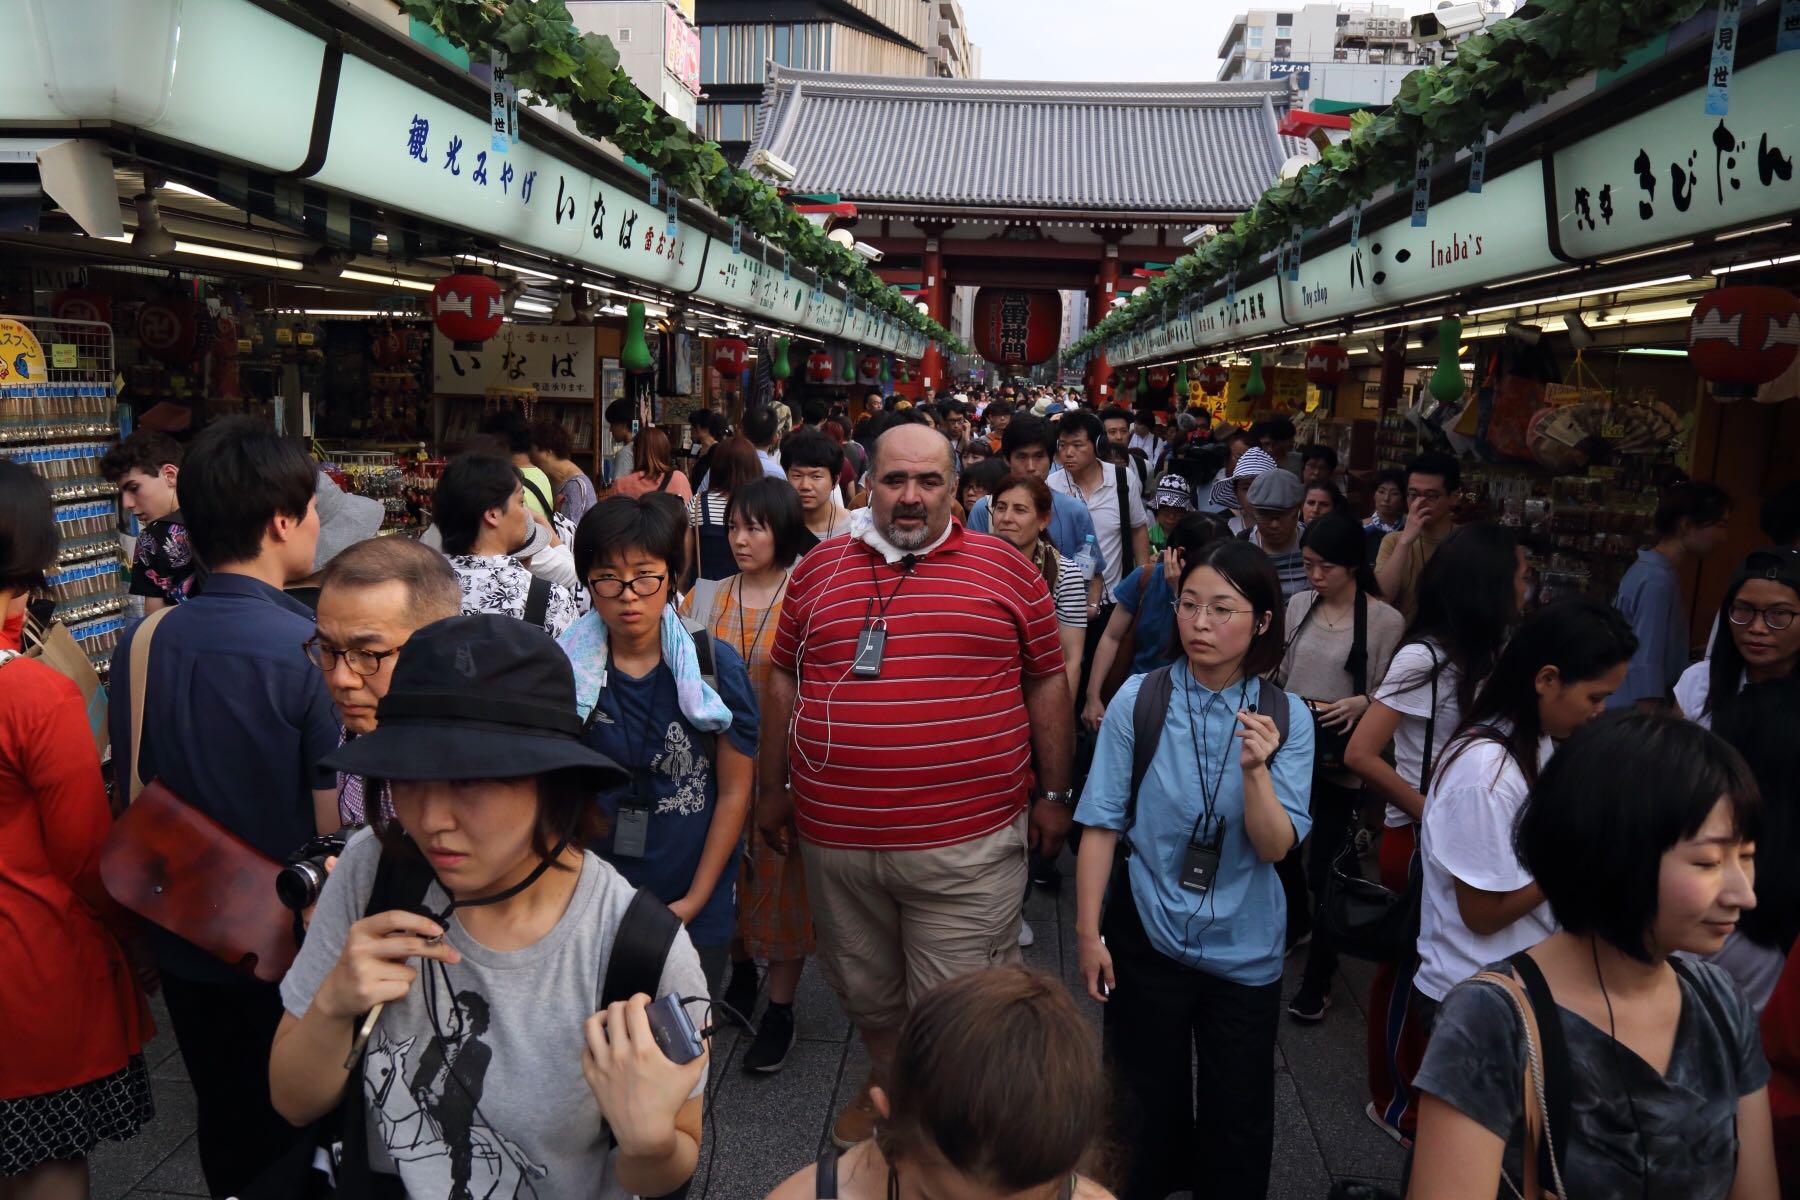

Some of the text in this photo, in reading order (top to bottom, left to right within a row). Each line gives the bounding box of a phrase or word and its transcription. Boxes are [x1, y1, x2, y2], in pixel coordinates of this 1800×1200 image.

[407, 113, 537, 204] 観光みやげ
[556, 176, 638, 249] いなば
[1634, 118, 1793, 220] きびだん
[1431, 233, 1482, 268] Inaba's
[1302, 280, 1328, 308] Toy shop
[1, 323, 13, 331] New
[449, 351, 578, 380] いなば
